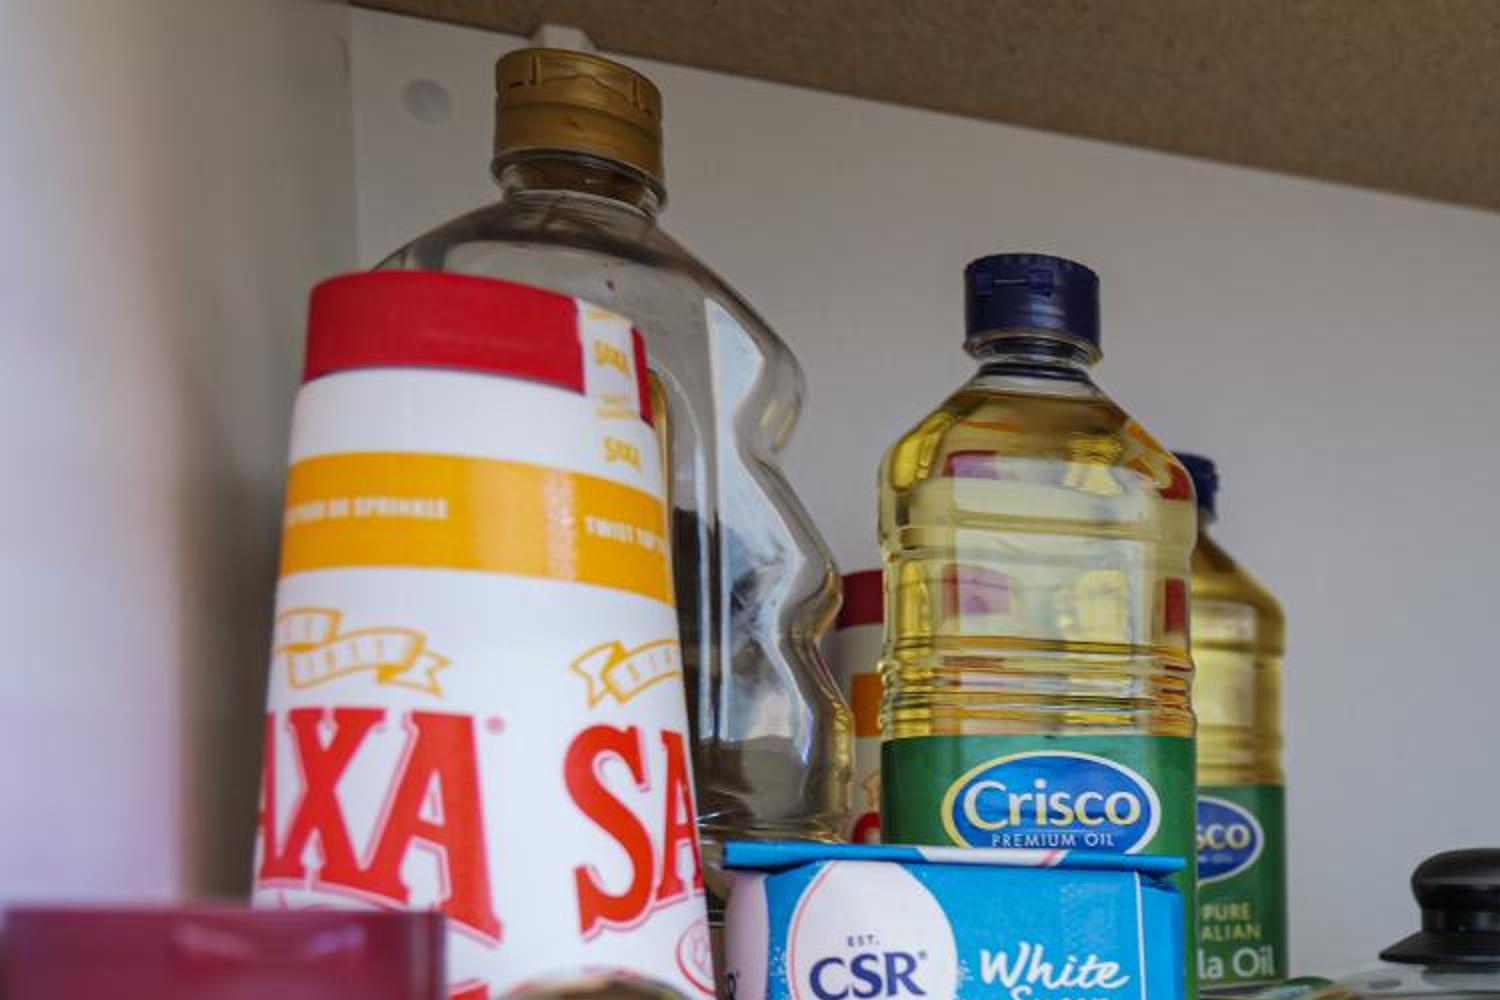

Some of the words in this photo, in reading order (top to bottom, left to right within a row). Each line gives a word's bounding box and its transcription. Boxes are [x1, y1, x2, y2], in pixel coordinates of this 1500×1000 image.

[354, 496, 449, 520] SPRINKLE
[962, 778, 1141, 831] Crisco
[991, 833, 1076, 848] PREMIUM
[1084, 831, 1115, 848] OIL
[1202, 903, 1251, 921] PURE
[847, 934, 880, 947] EST.
[979, 941, 1130, 991] White
[1232, 945, 1275, 978] Oil
